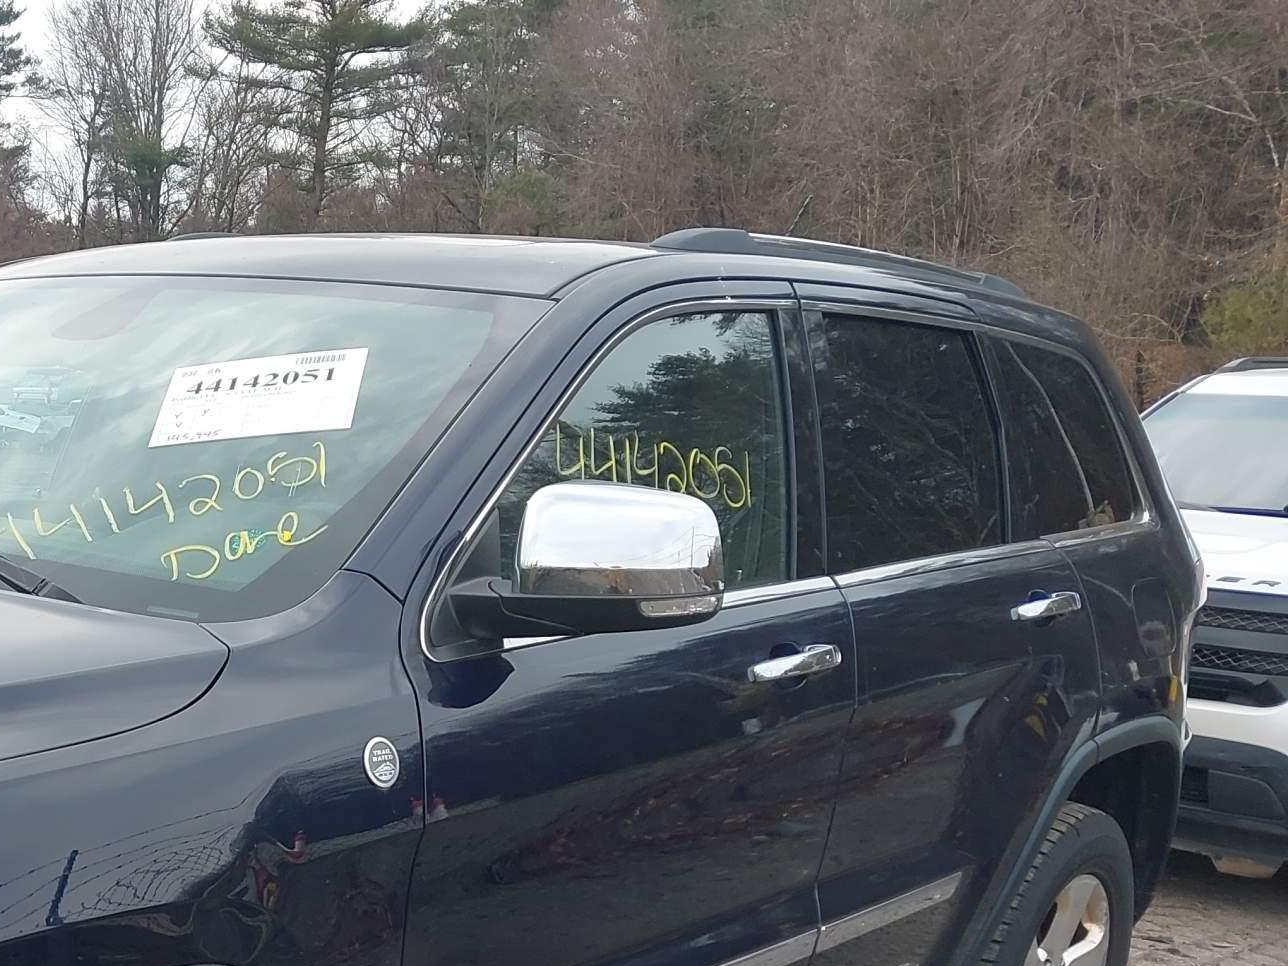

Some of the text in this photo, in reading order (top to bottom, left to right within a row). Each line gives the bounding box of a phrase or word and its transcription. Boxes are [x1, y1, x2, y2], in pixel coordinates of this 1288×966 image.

[186, 367, 335, 395] 44142051
[556, 423, 751, 508] 44142051
[372, 748, 392, 757] TRAIL
